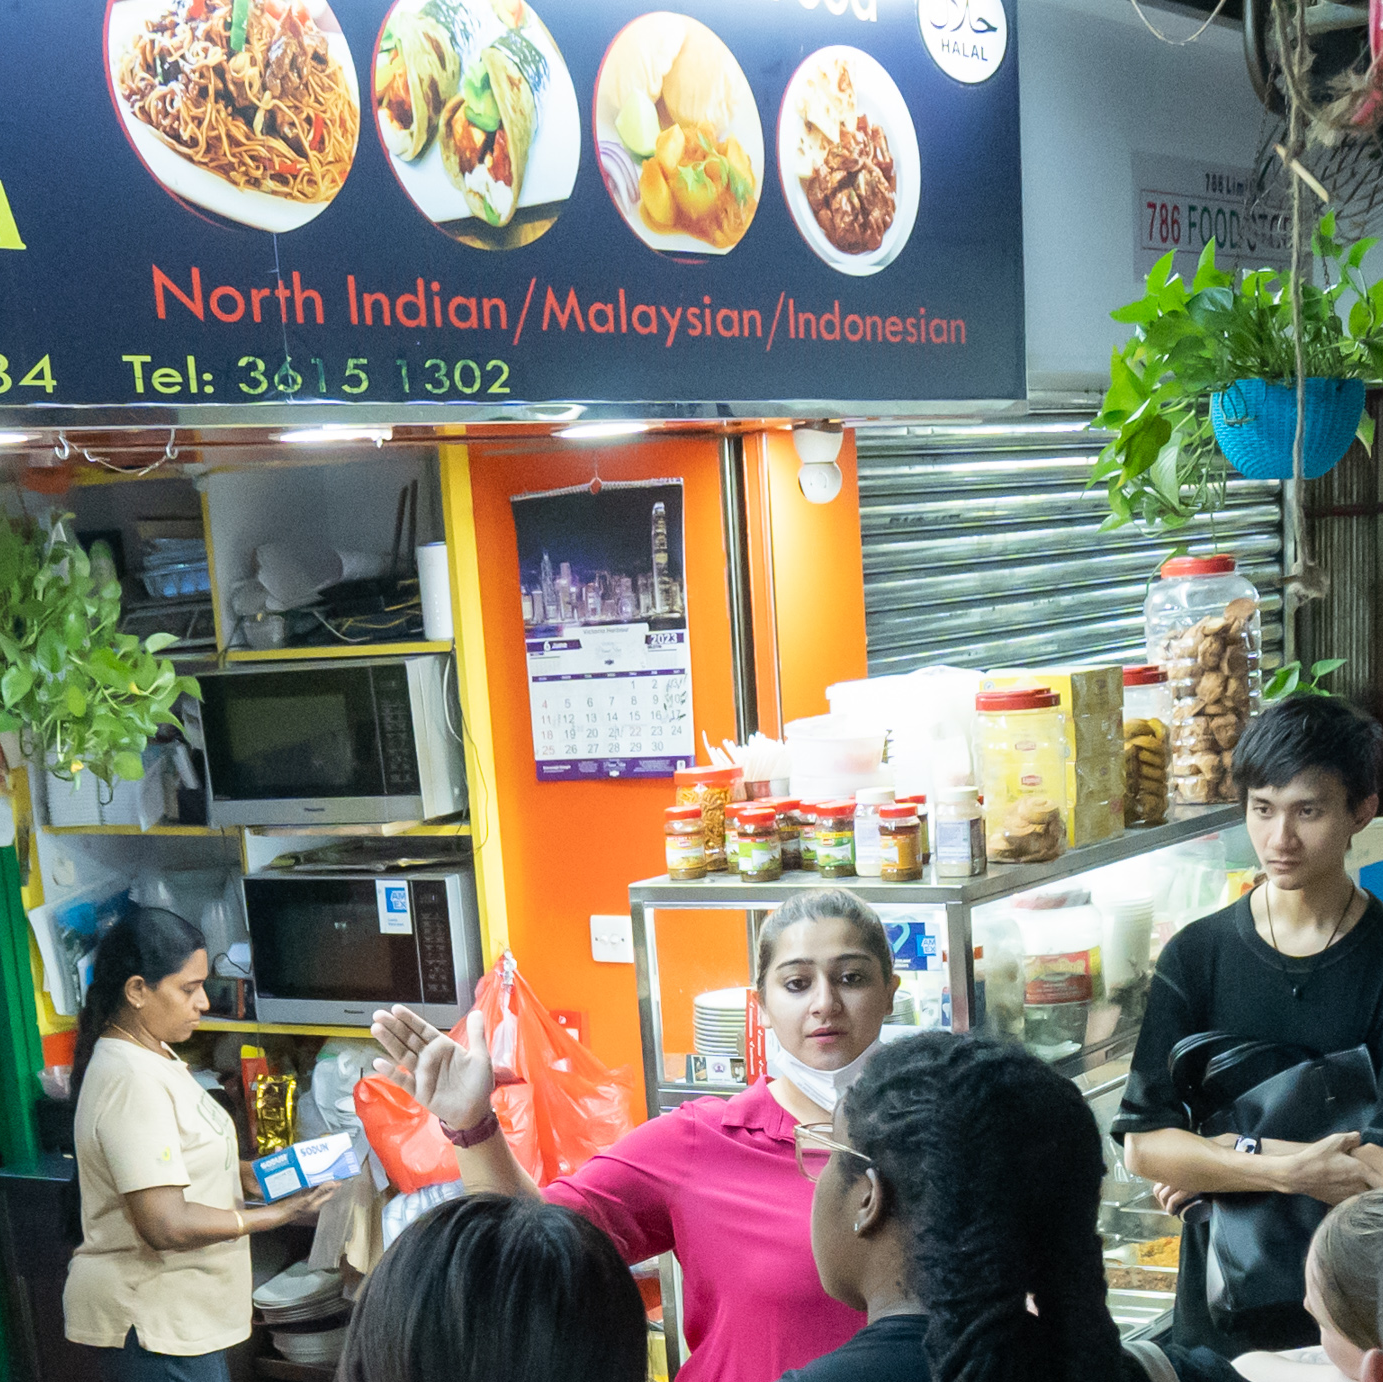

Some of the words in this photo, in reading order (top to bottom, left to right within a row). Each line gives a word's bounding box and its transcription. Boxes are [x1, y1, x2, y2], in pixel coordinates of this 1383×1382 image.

[941, 38, 989, 62] HALAL
[1146, 201, 1181, 245] 786
[1188, 205, 1241, 250] FOOD
[151, 264, 326, 326] North
[347, 273, 968, 353] Indian/Malaysian/Indonesian
[122, 353, 215, 396] Tel:
[395, 358, 511, 395] 1302
[543, 640, 551, 651] 6
[650, 632, 678, 645] 2023
[632, 681, 635, 689] 1
[652, 680, 658, 689] 2
[542, 700, 548, 709] 4
[565, 699, 571, 709] 5
[587, 698, 593, 707] 6
[609, 696, 614, 706] 7
[631, 696, 637, 705] 8
[653, 695, 658, 705] 9
[542, 715, 551, 724] 11
[564, 714, 575, 724] 12
[586, 714, 597, 723] 13
[607, 712, 618, 722] 14
[630, 712, 640, 720] 15
[651, 711, 662, 720] 16
[542, 730, 553, 740] 18
[565, 729, 576, 739] 19
[586, 729, 598, 738] 20
[630, 727, 641, 737] 22
[651, 726, 663, 736] 23
[671, 725, 682, 734] 24
[542, 746, 555, 755] 25
[565, 745, 577, 754] 26
[588, 744, 599, 753] 27
[608, 743, 620, 753] 28
[630, 743, 642, 752] 29
[651, 742, 663, 751] 30
